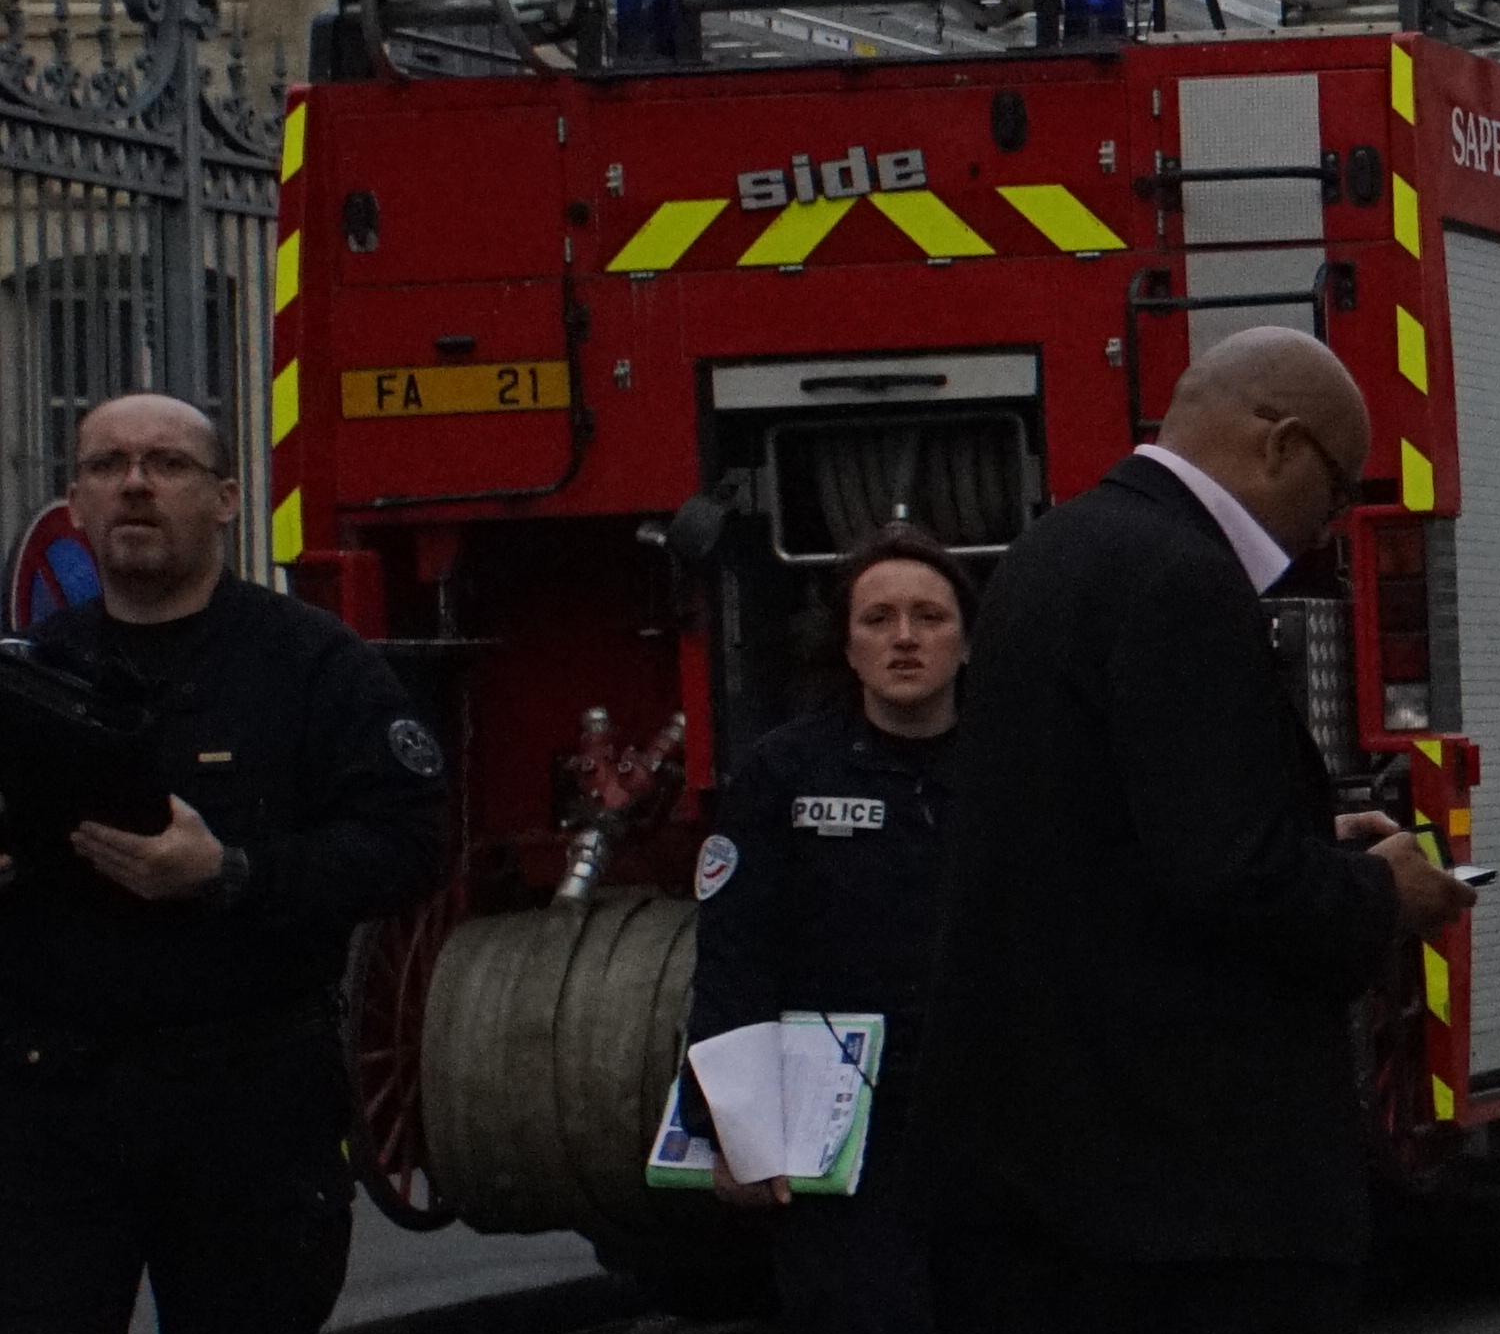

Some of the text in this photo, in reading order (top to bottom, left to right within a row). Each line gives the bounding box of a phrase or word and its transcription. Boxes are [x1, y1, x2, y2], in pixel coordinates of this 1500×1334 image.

[737, 145, 927, 211] side
[377, 367, 539, 410] FA 21
[792, 801, 884, 824] POLICE
